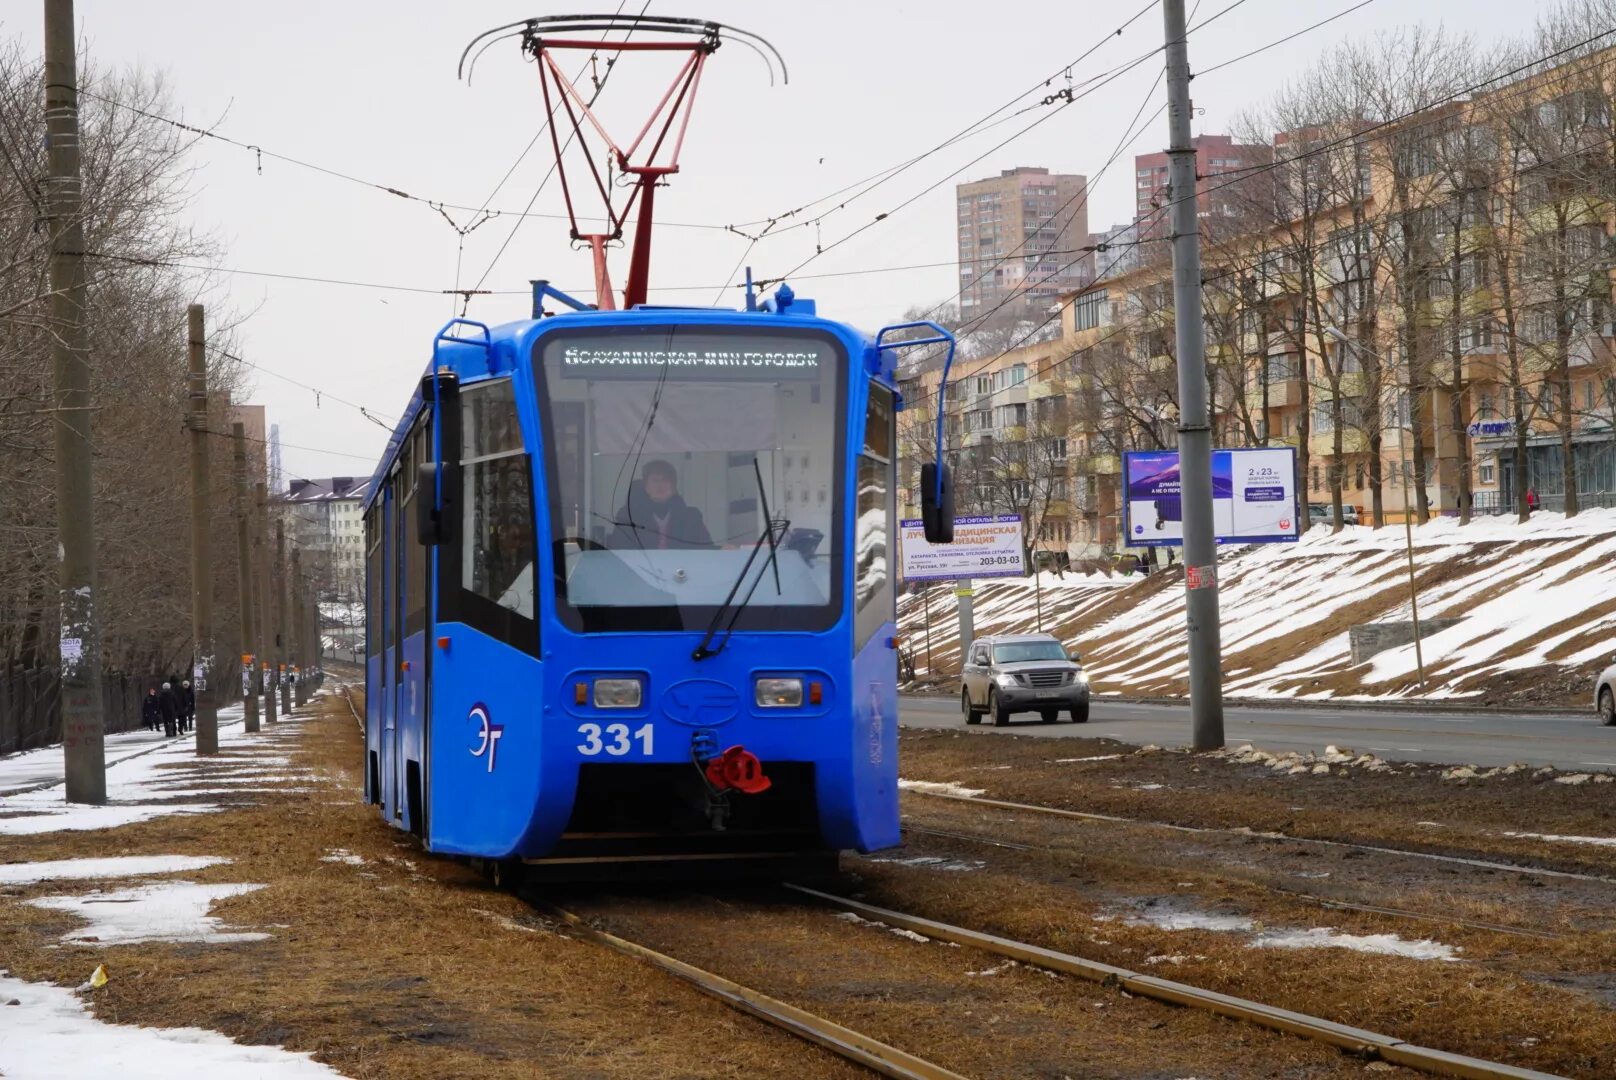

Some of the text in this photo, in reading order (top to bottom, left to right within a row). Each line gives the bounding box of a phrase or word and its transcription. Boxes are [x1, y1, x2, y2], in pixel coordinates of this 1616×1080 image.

[1261, 467, 1272, 475] 23
[955, 526, 1017, 537] ЕДИЦИНСКАЯ
[979, 555, 1020, 566] 203-03-03
[577, 723, 655, 756] 331
